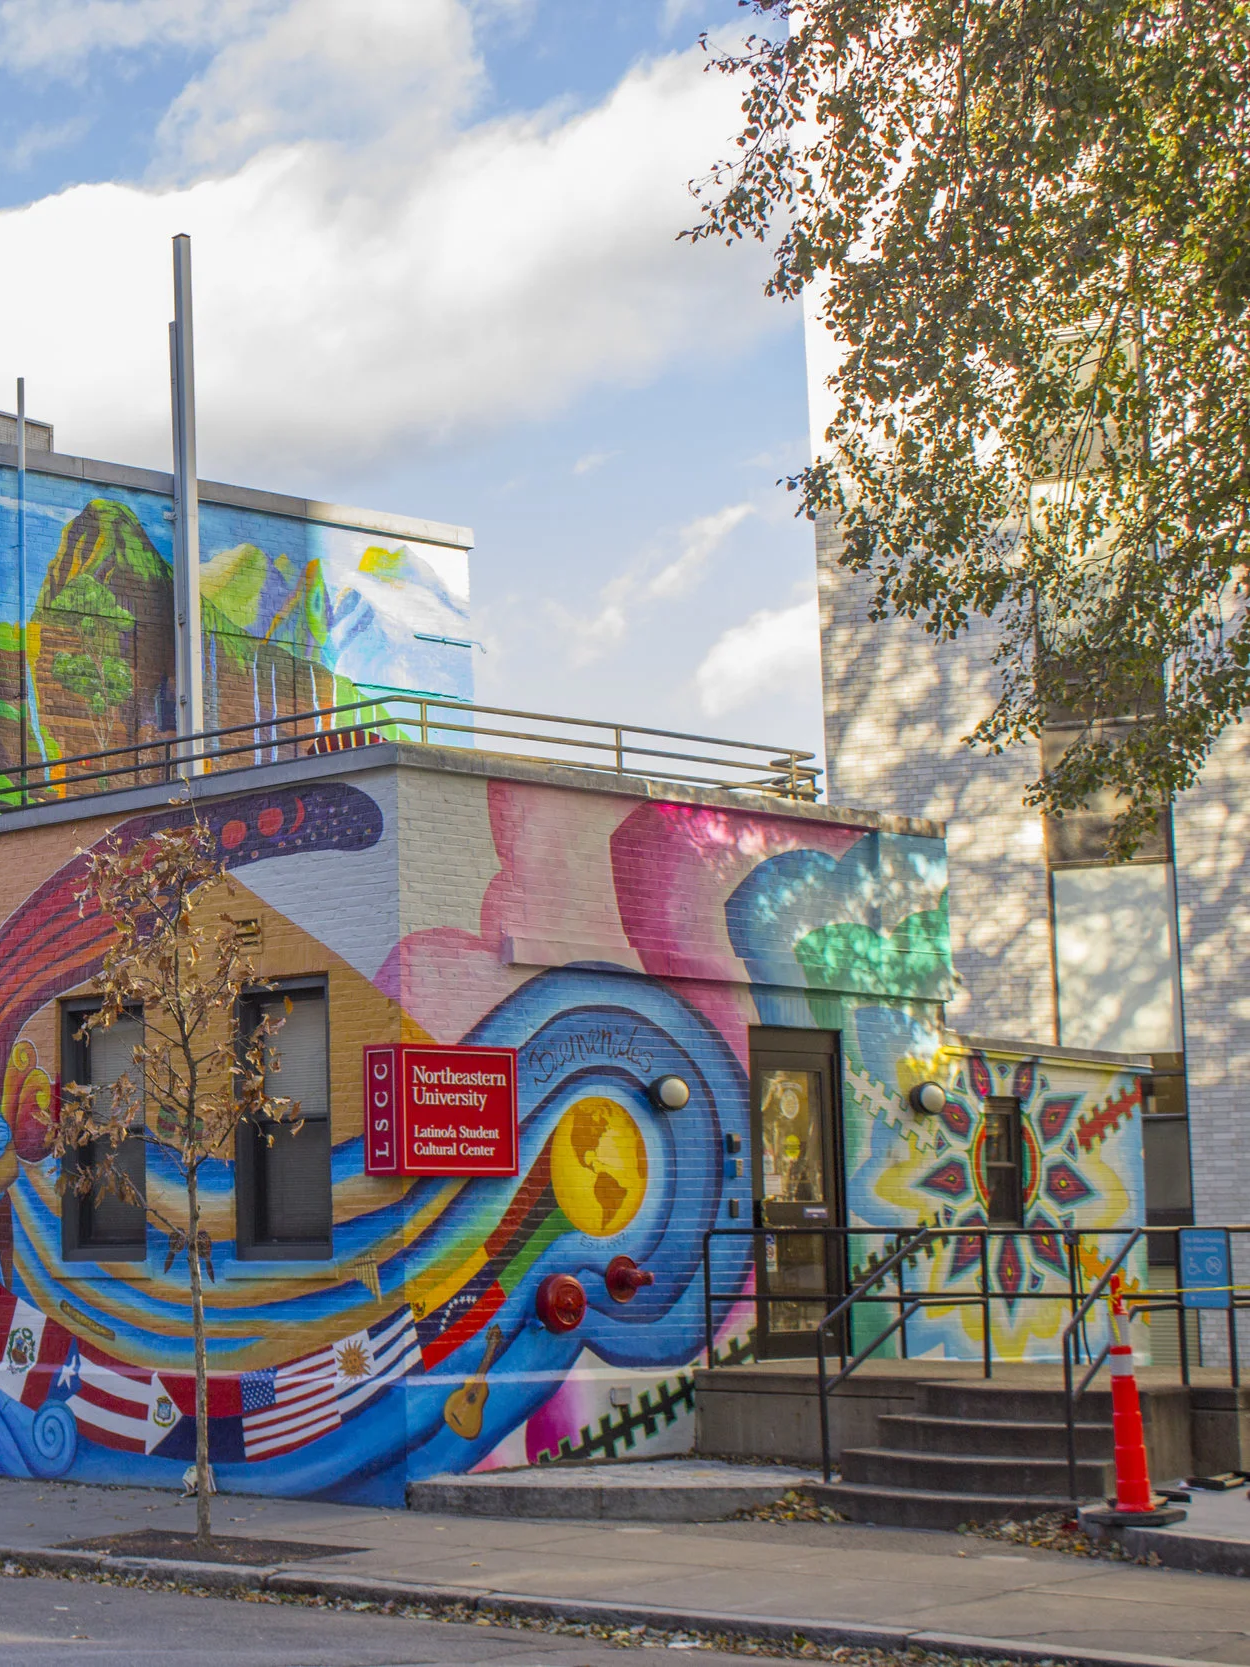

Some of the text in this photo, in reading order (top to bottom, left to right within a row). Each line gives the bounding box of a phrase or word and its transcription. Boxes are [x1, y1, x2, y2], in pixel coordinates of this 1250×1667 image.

[411, 1065, 507, 1086] Northeastern
[411, 1086, 488, 1112] University
[413, 1124, 500, 1139] Latino/a Student
[413, 1142, 496, 1156] Cultural Center
